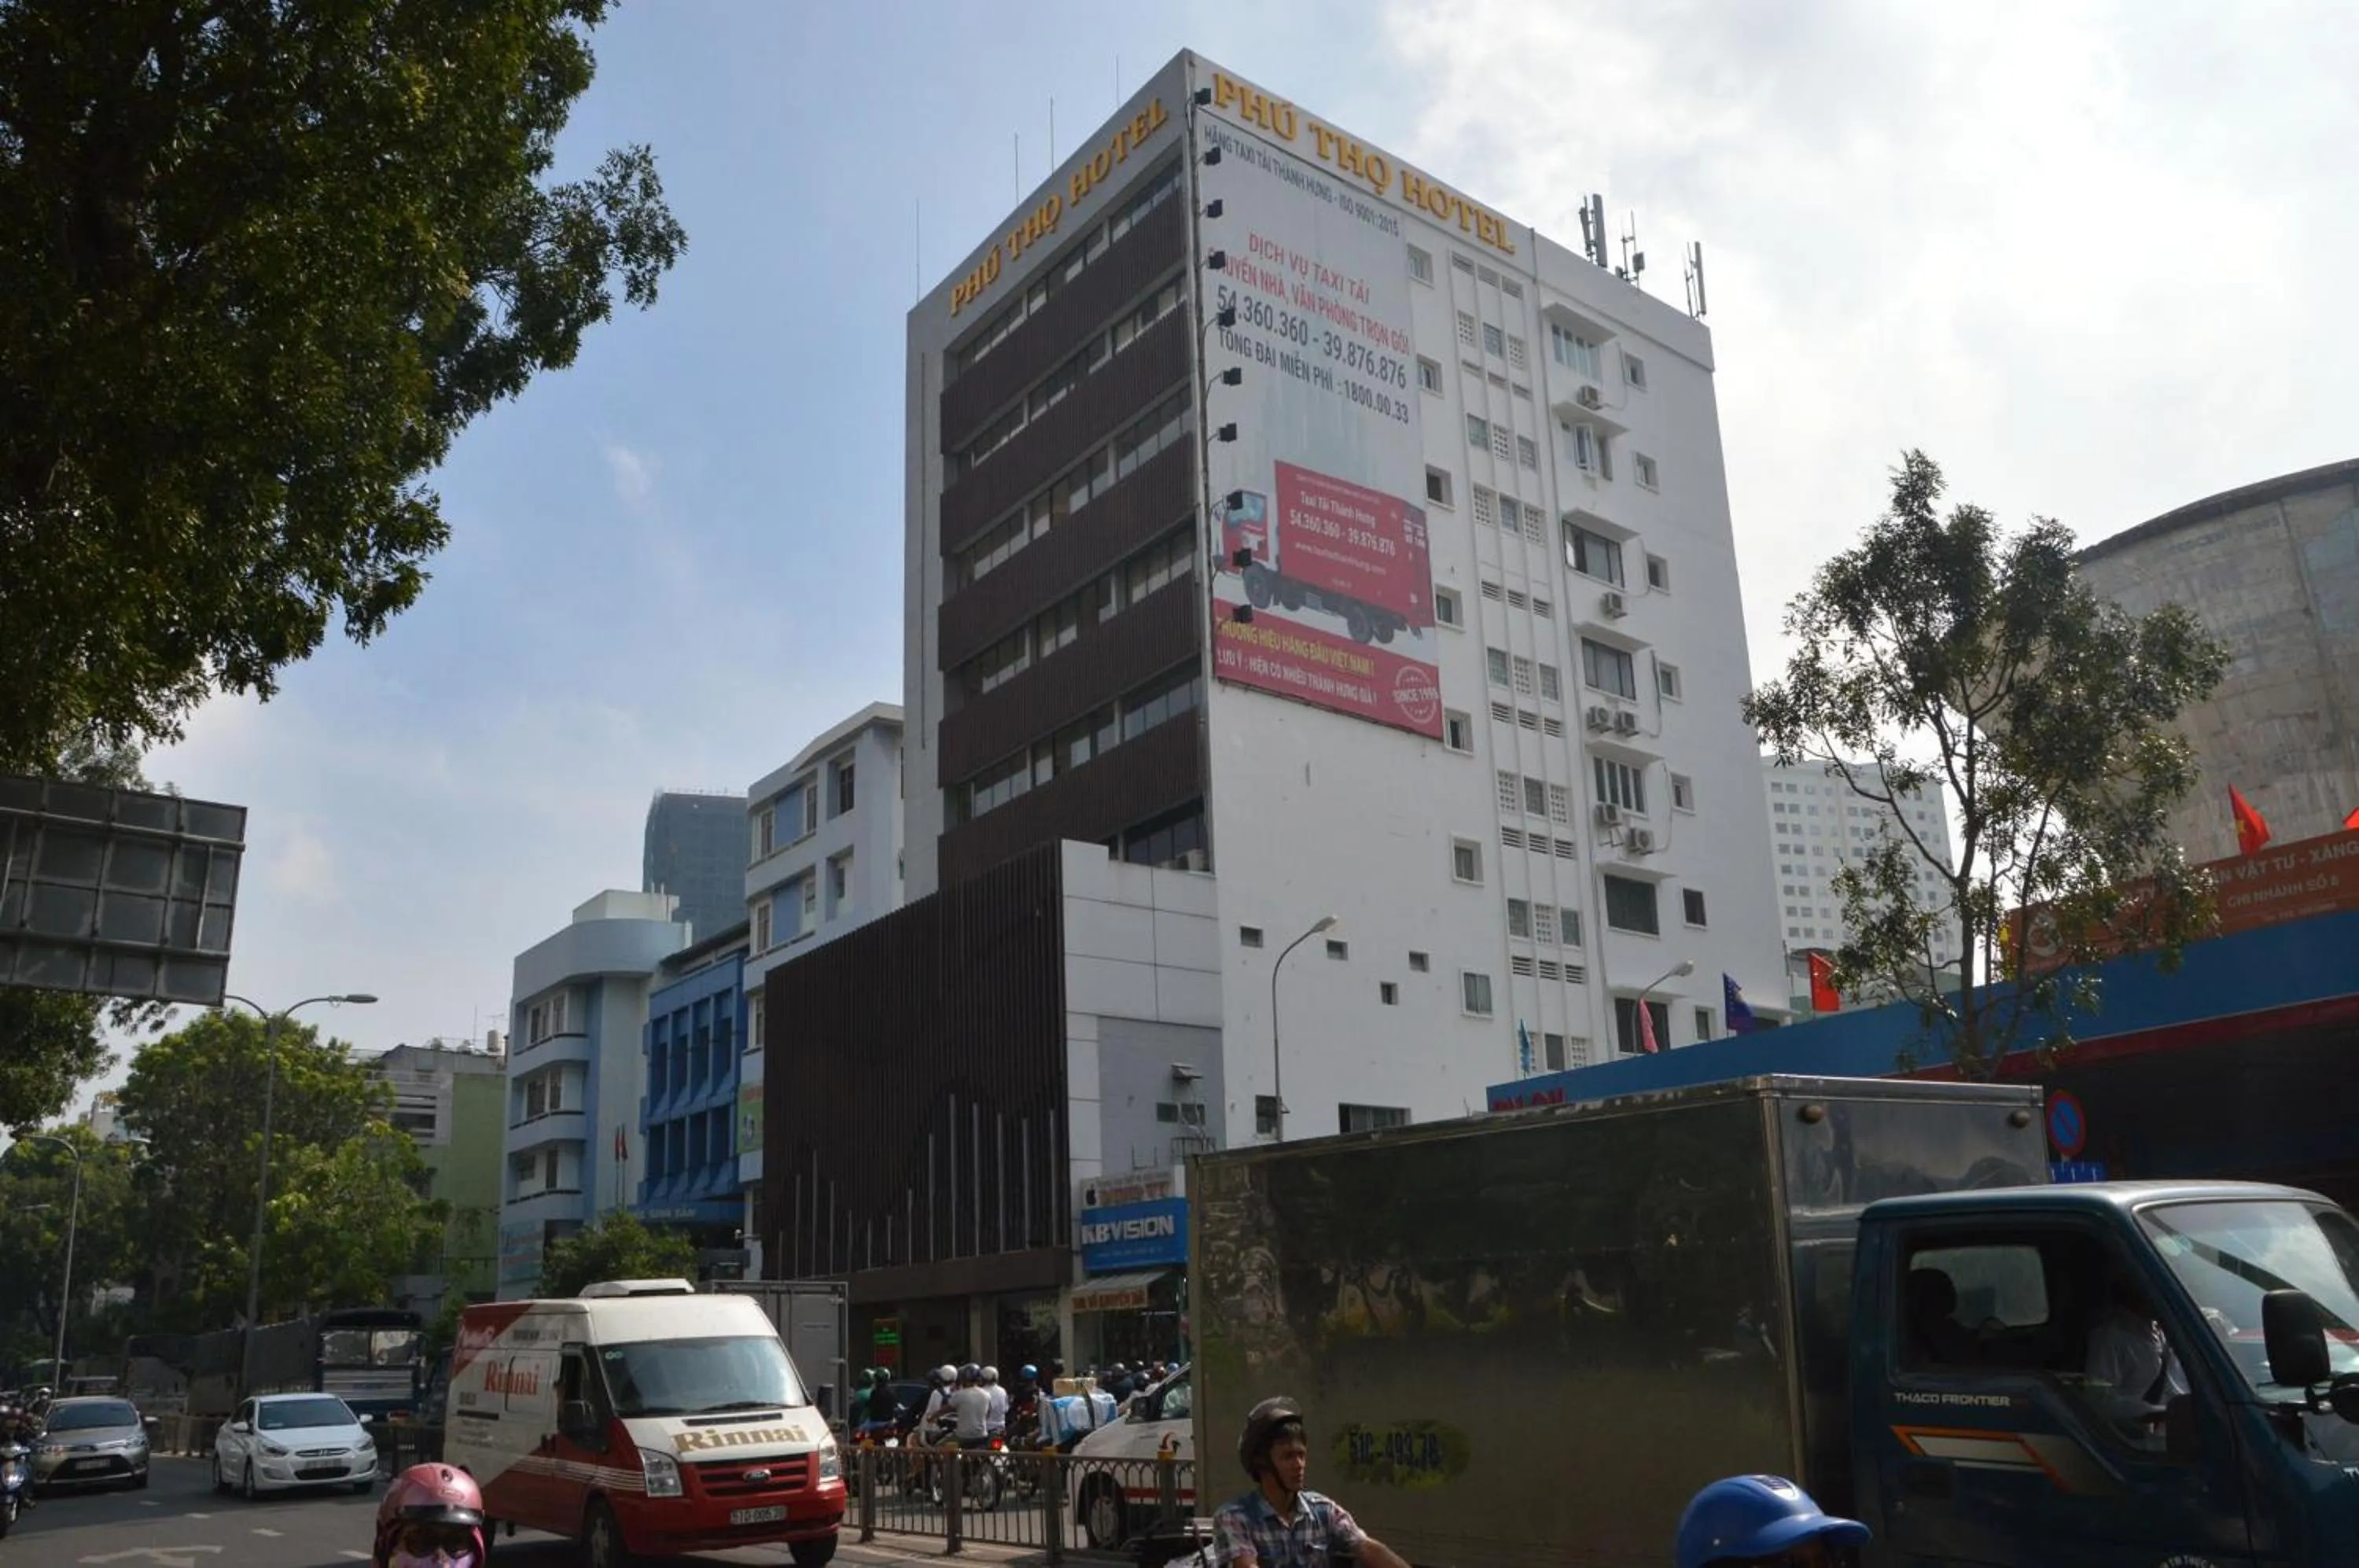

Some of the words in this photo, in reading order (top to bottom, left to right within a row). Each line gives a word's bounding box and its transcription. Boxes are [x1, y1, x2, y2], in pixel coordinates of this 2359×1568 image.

[1213, 72, 1297, 142] PHÚ
[1308, 121, 1393, 196] THỌ
[1400, 169, 1515, 255] HOTEL
[1234, 139, 1256, 164] TAXI
[951, 244, 1002, 317] PHÚ
[1007, 194, 1063, 261] THỌ
[1069, 97, 1170, 208] HOTEL
[1249, 234, 1284, 265] DỊCH
[1290, 249, 1308, 280] VỤ
[1313, 263, 1344, 291] TAXI
[1217, 285, 1308, 347] 54.360.360
[1323, 330, 1406, 389] 39.876.876
[1313, 365, 1333, 392] PHÍ
[1081, 1215, 1175, 1246] KBVISION
[485, 1360, 539, 1396] Rinnai
[1893, 1392, 1940, 1405] THACO
[1941, 1393, 2011, 1408] FRONTIER
[672, 1425, 809, 1452] Rinnai
